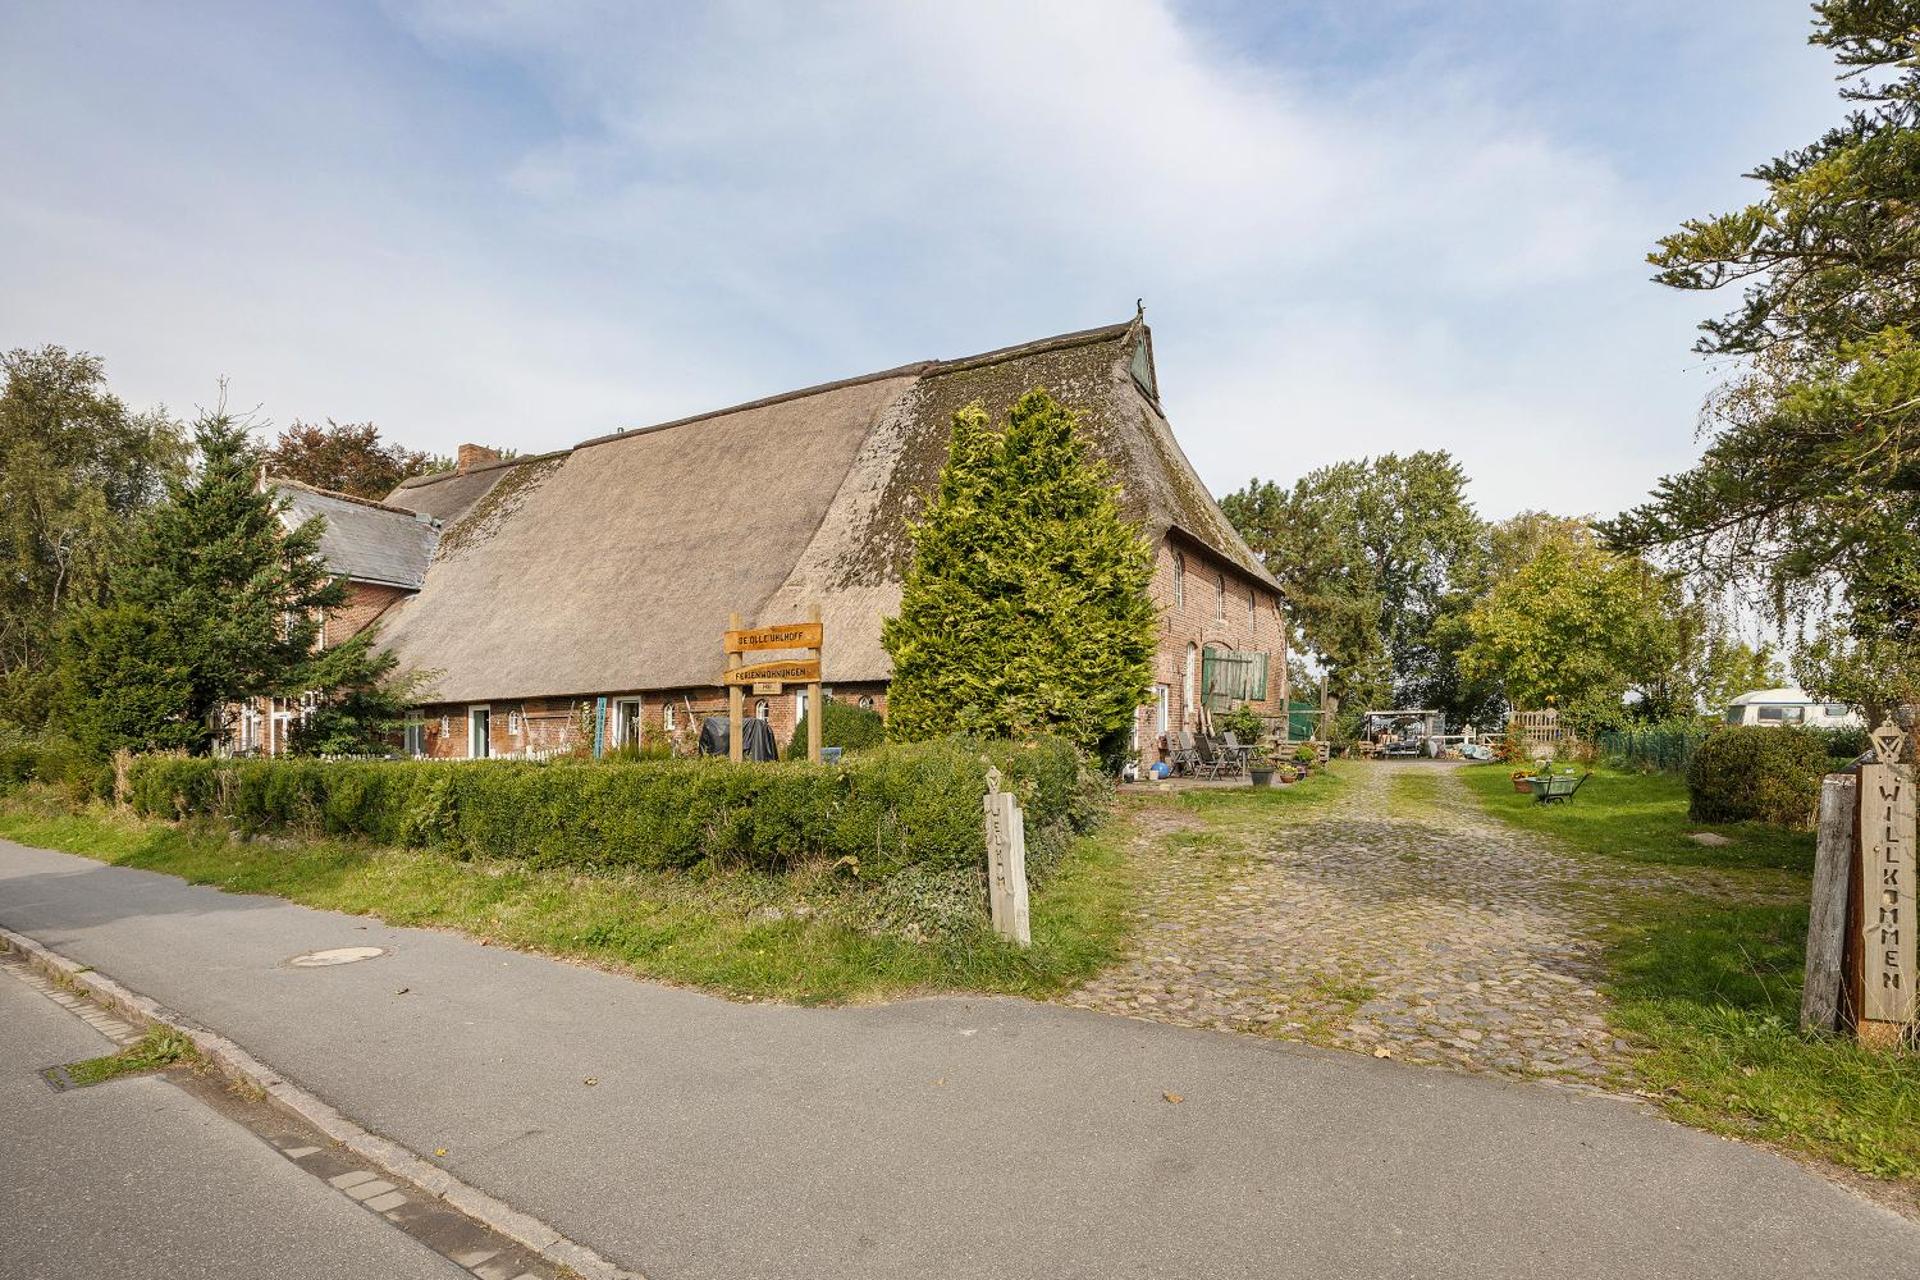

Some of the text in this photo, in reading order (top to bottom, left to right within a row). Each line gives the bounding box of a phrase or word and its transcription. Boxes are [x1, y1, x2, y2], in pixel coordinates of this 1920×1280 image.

[749, 634, 769, 645] OLLE
[735, 667, 806, 681] FERIENWOHNUNGEN
[1878, 785, 1900, 990] WILLKOMMEN
